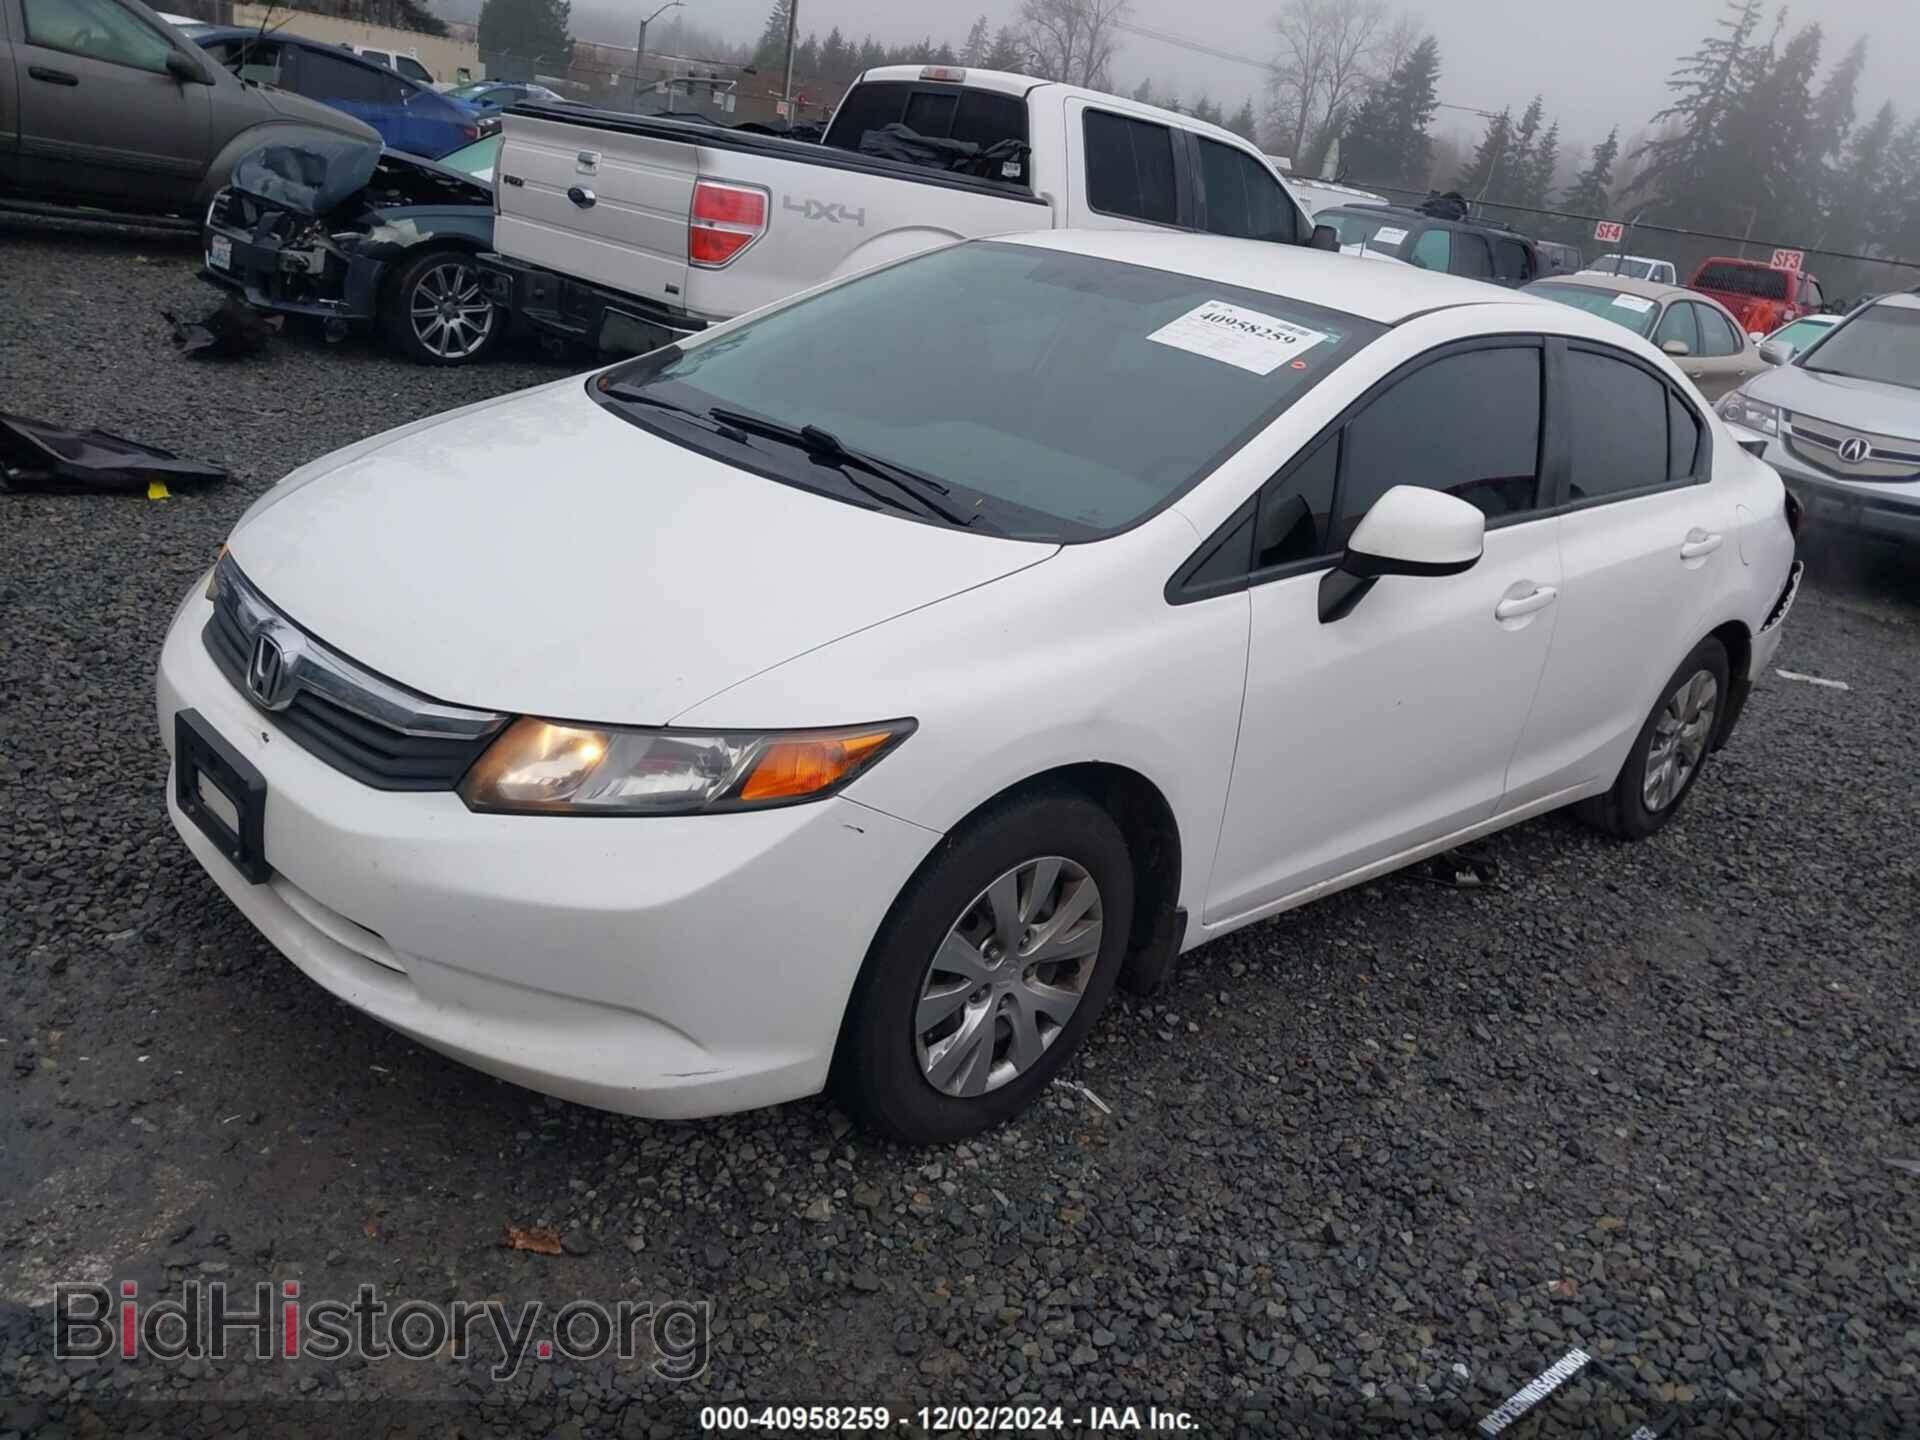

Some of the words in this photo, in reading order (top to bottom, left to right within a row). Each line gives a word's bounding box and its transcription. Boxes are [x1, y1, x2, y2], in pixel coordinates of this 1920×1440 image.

[1597, 223, 1621, 240] SF4
[1774, 251, 1801, 269] SF3
[1200, 311, 1297, 344] 40958259
